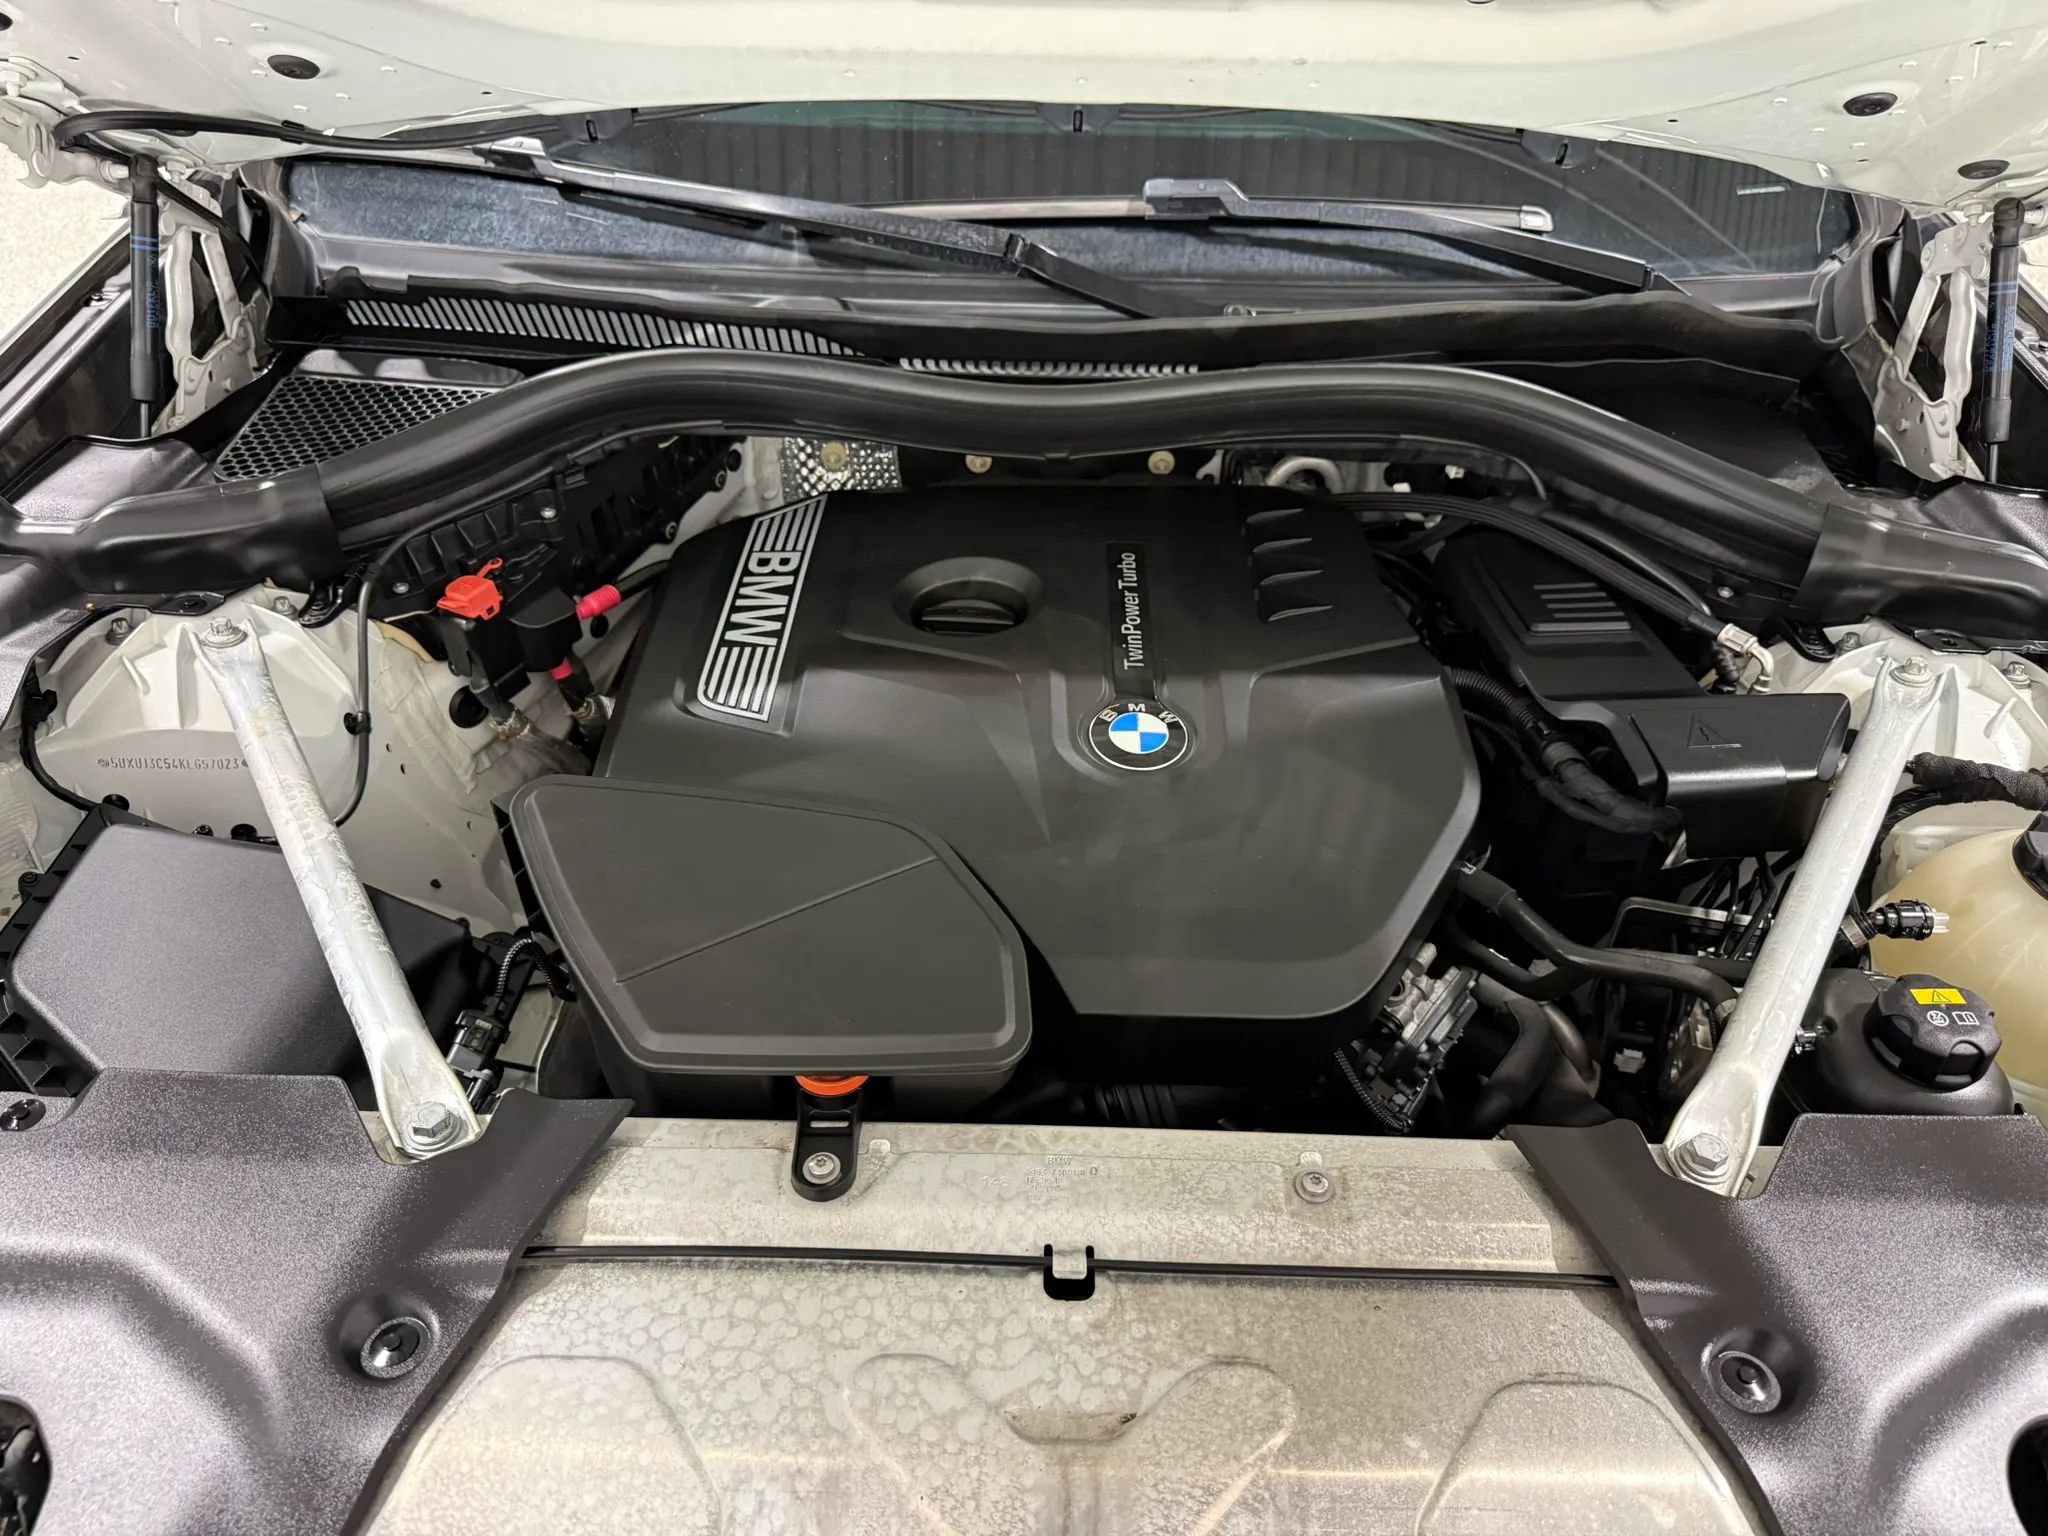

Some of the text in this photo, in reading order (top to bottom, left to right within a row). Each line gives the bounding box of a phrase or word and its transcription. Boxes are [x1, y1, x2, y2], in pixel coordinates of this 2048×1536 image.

[724, 551, 802, 646] BMW
[1117, 552, 1144, 670] TwinPower Turbo
[1099, 703, 1178, 723] BMW
